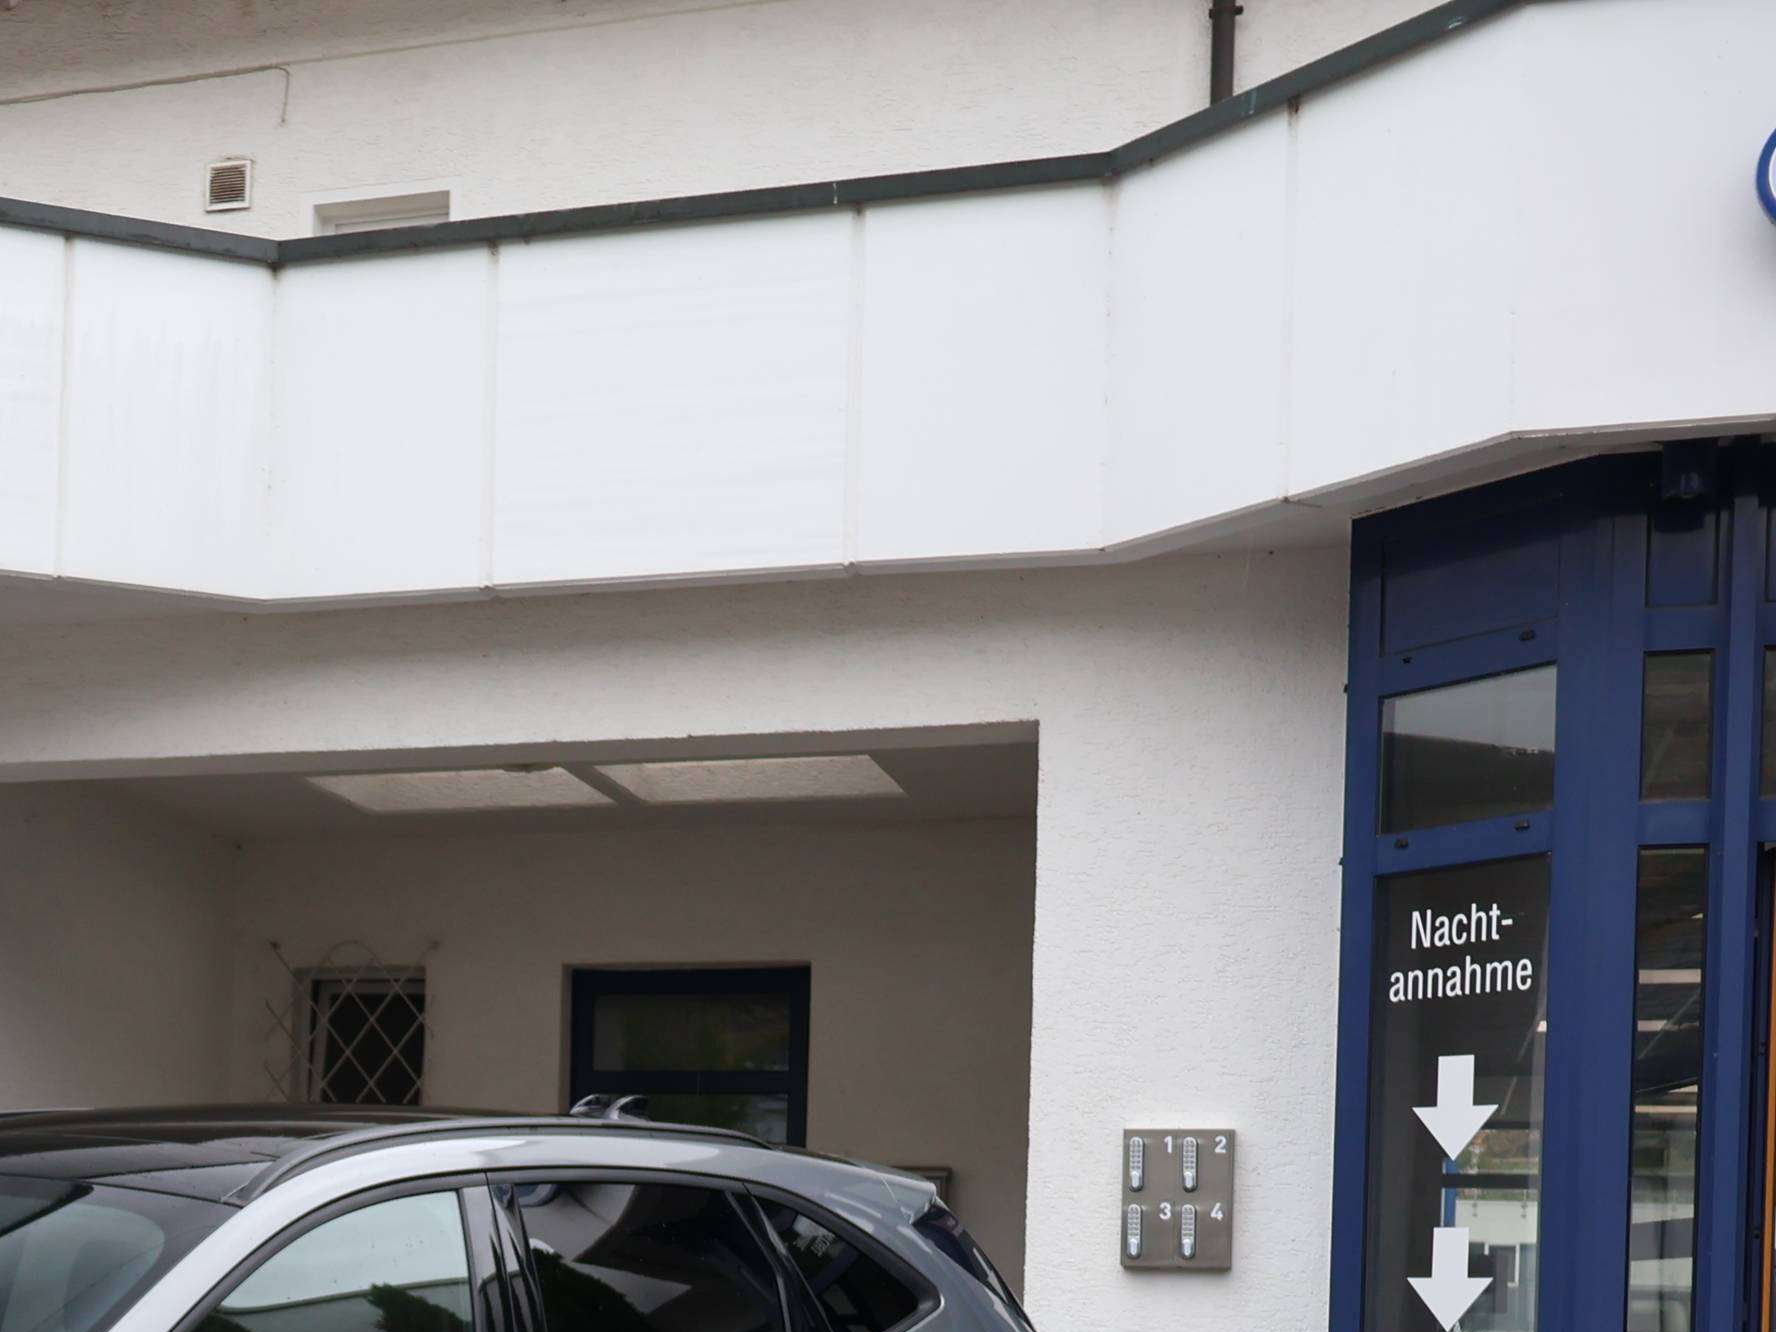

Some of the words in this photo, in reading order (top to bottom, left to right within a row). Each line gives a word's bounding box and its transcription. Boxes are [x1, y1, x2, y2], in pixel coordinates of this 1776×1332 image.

[1411, 903, 1513, 949] Nacht-
[1389, 955, 1533, 1002] annahme
[1164, 1135, 1173, 1154] 1
[1214, 1135, 1227, 1154] 2
[1159, 1202, 1172, 1220] 3
[1210, 1202, 1224, 1221] 4
